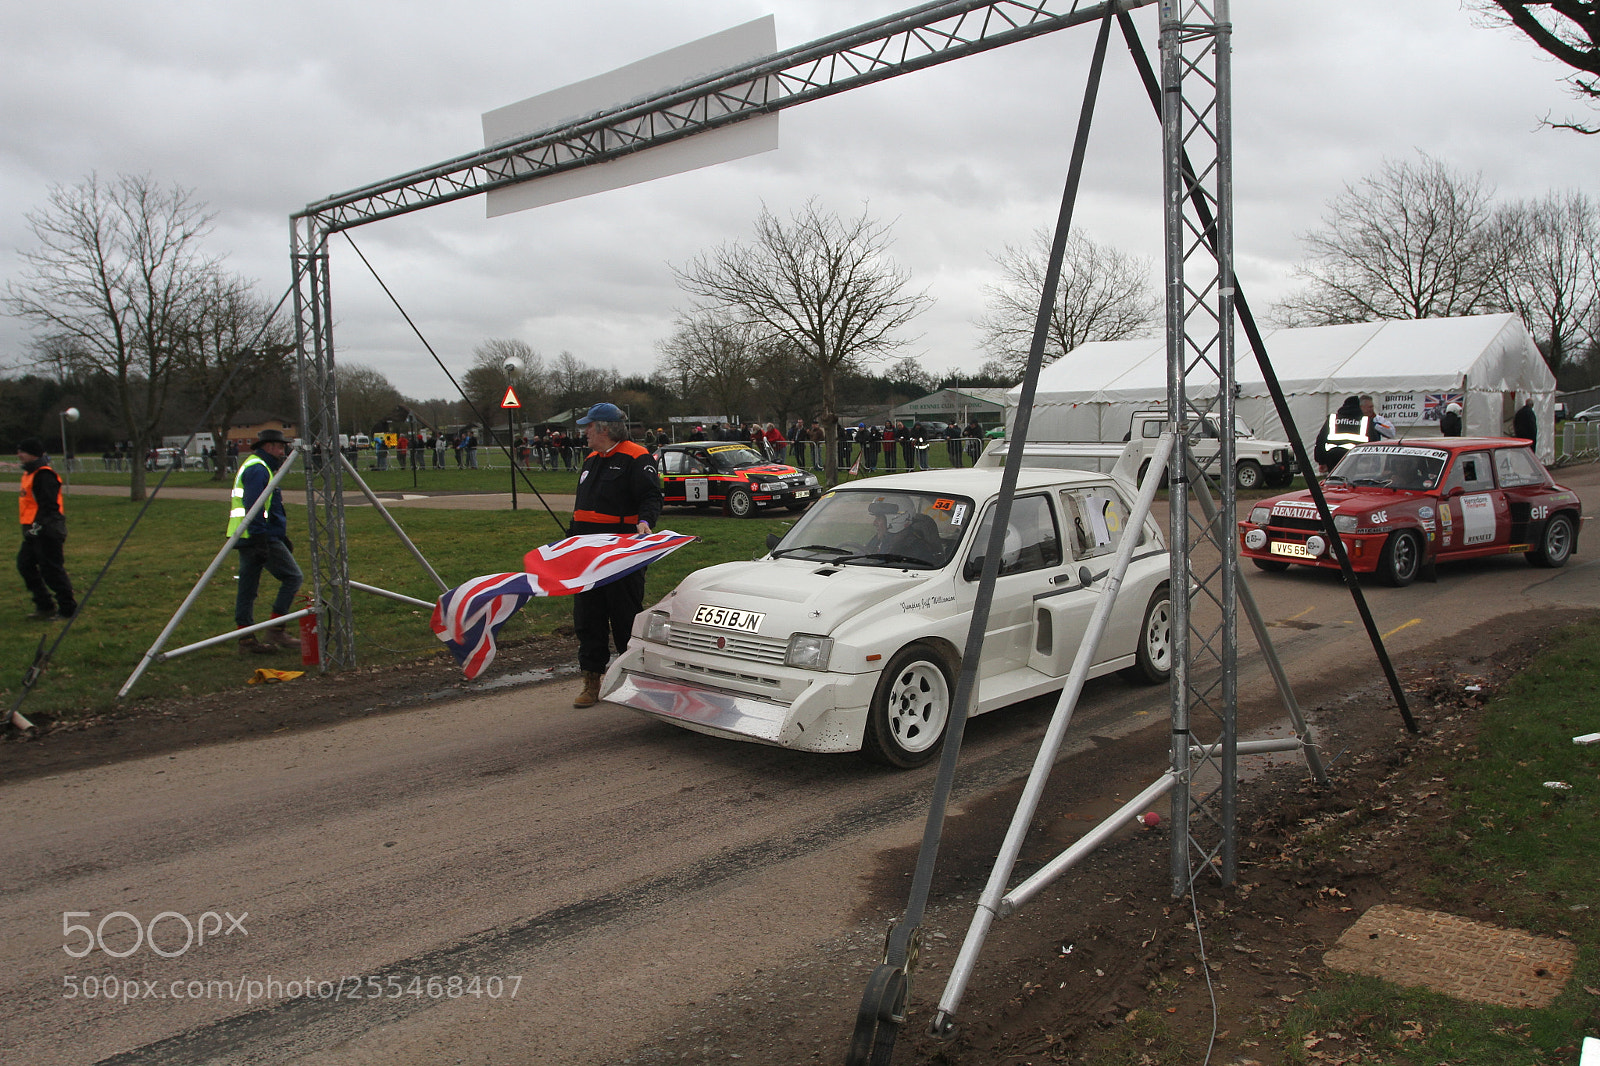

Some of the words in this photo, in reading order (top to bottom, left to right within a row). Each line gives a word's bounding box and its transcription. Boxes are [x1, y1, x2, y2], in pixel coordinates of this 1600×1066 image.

[1382, 403, 1416, 411] HISTORIC
[1361, 446, 1403, 454] RENAULT
[694, 487, 700, 499] 3
[935, 501, 951, 510] 34
[1271, 506, 1317, 520] RENAULT
[1371, 510, 1388, 524] elf
[1530, 505, 1549, 520] elf
[1467, 533, 1492, 543] RENAULT
[1277, 543, 1293, 554] VVS
[695, 606, 760, 631] E651BJN
